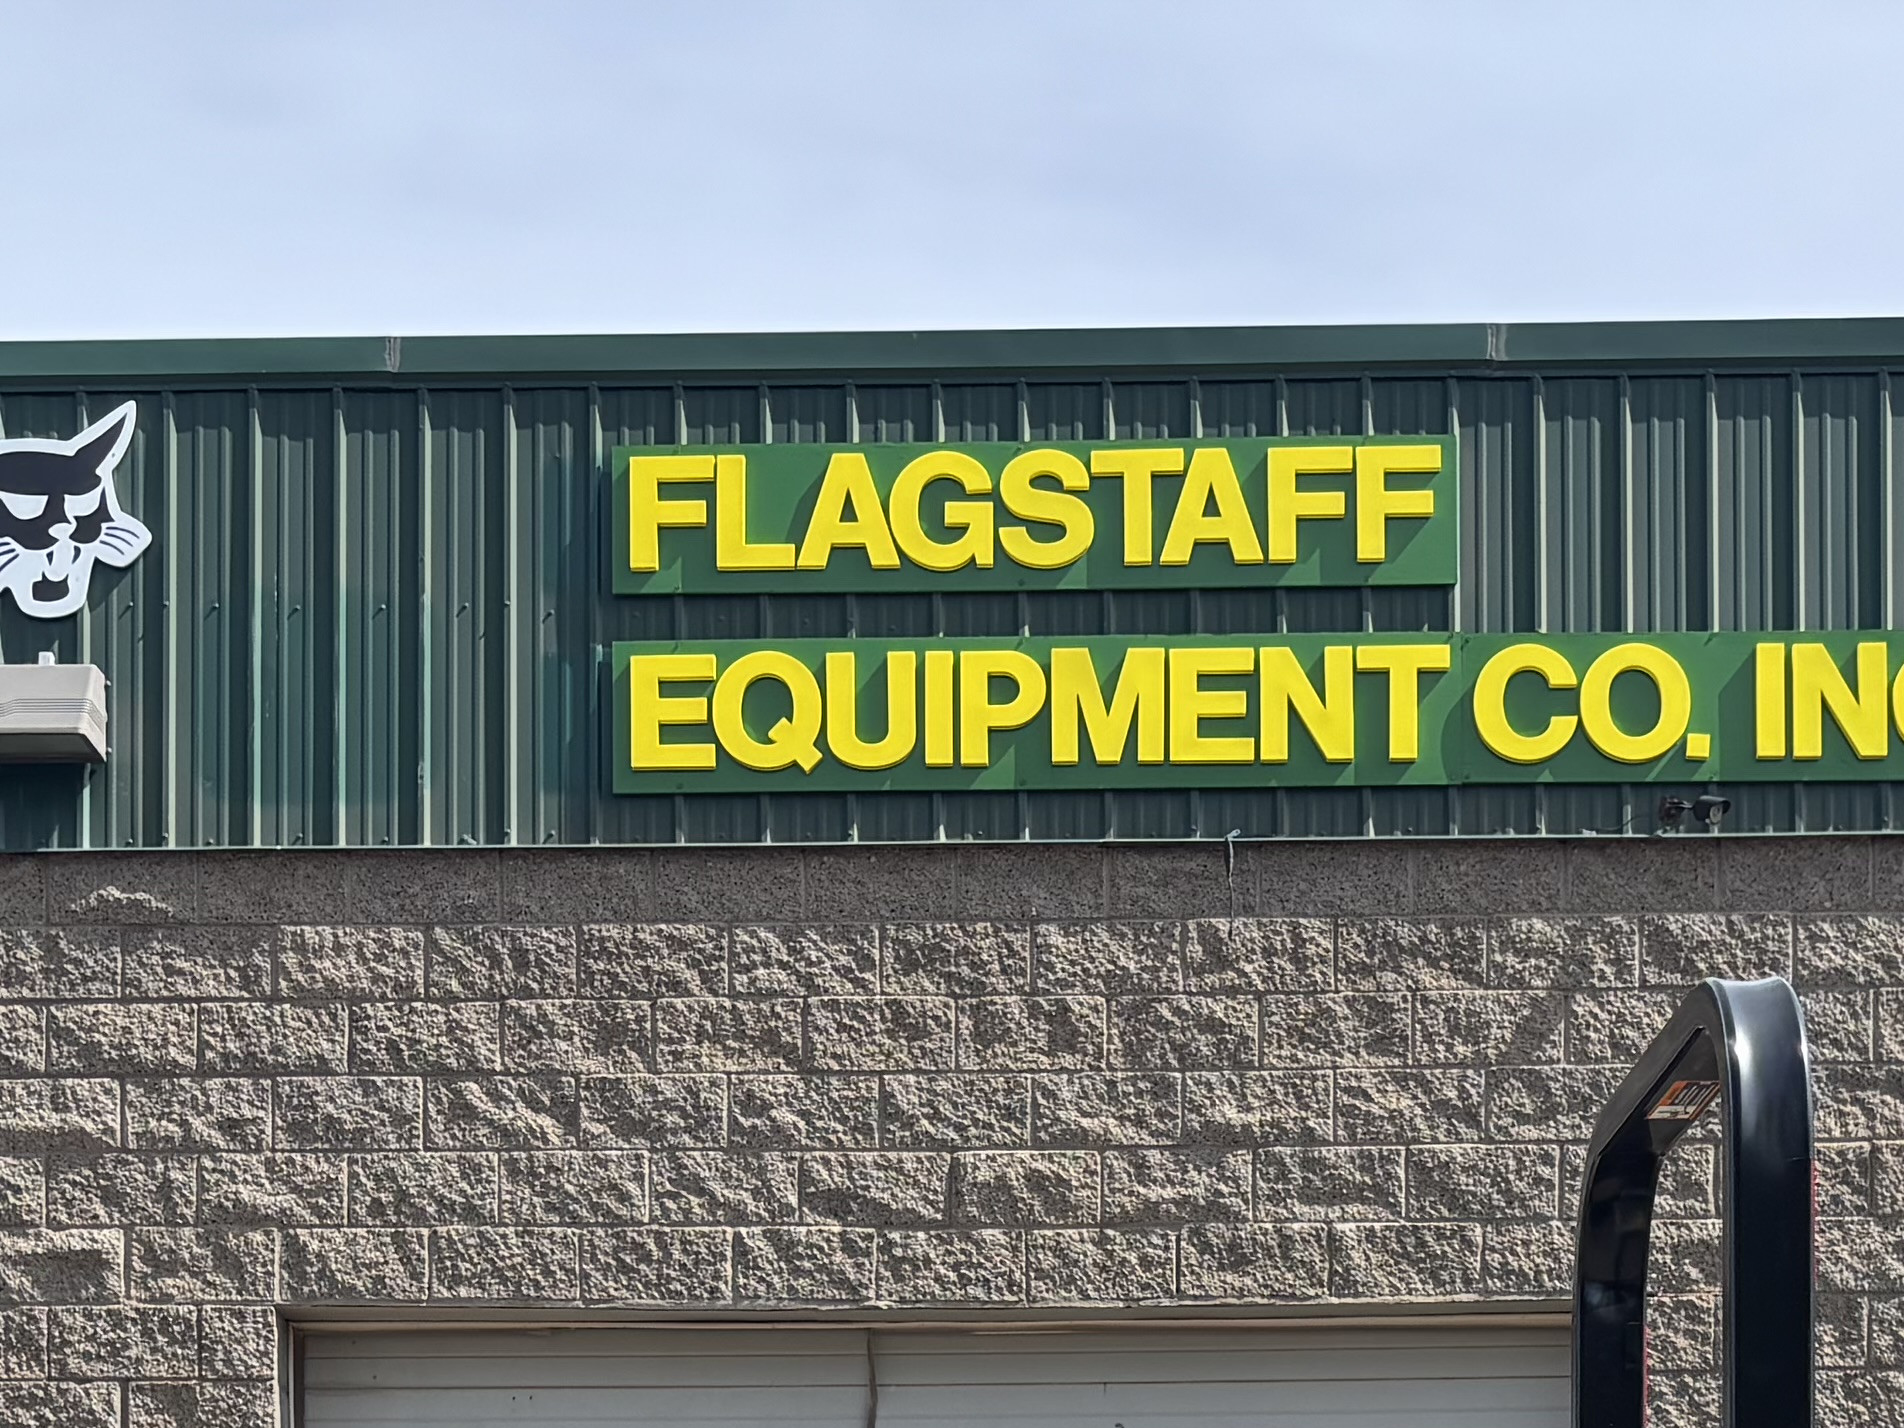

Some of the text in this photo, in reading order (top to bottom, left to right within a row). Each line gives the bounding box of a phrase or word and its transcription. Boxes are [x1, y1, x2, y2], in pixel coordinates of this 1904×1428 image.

[628, 445, 1443, 571] FLAGSTAFF
[630, 644, 1451, 773] EQUIPMENT
[1473, 645, 1712, 763] CO.
